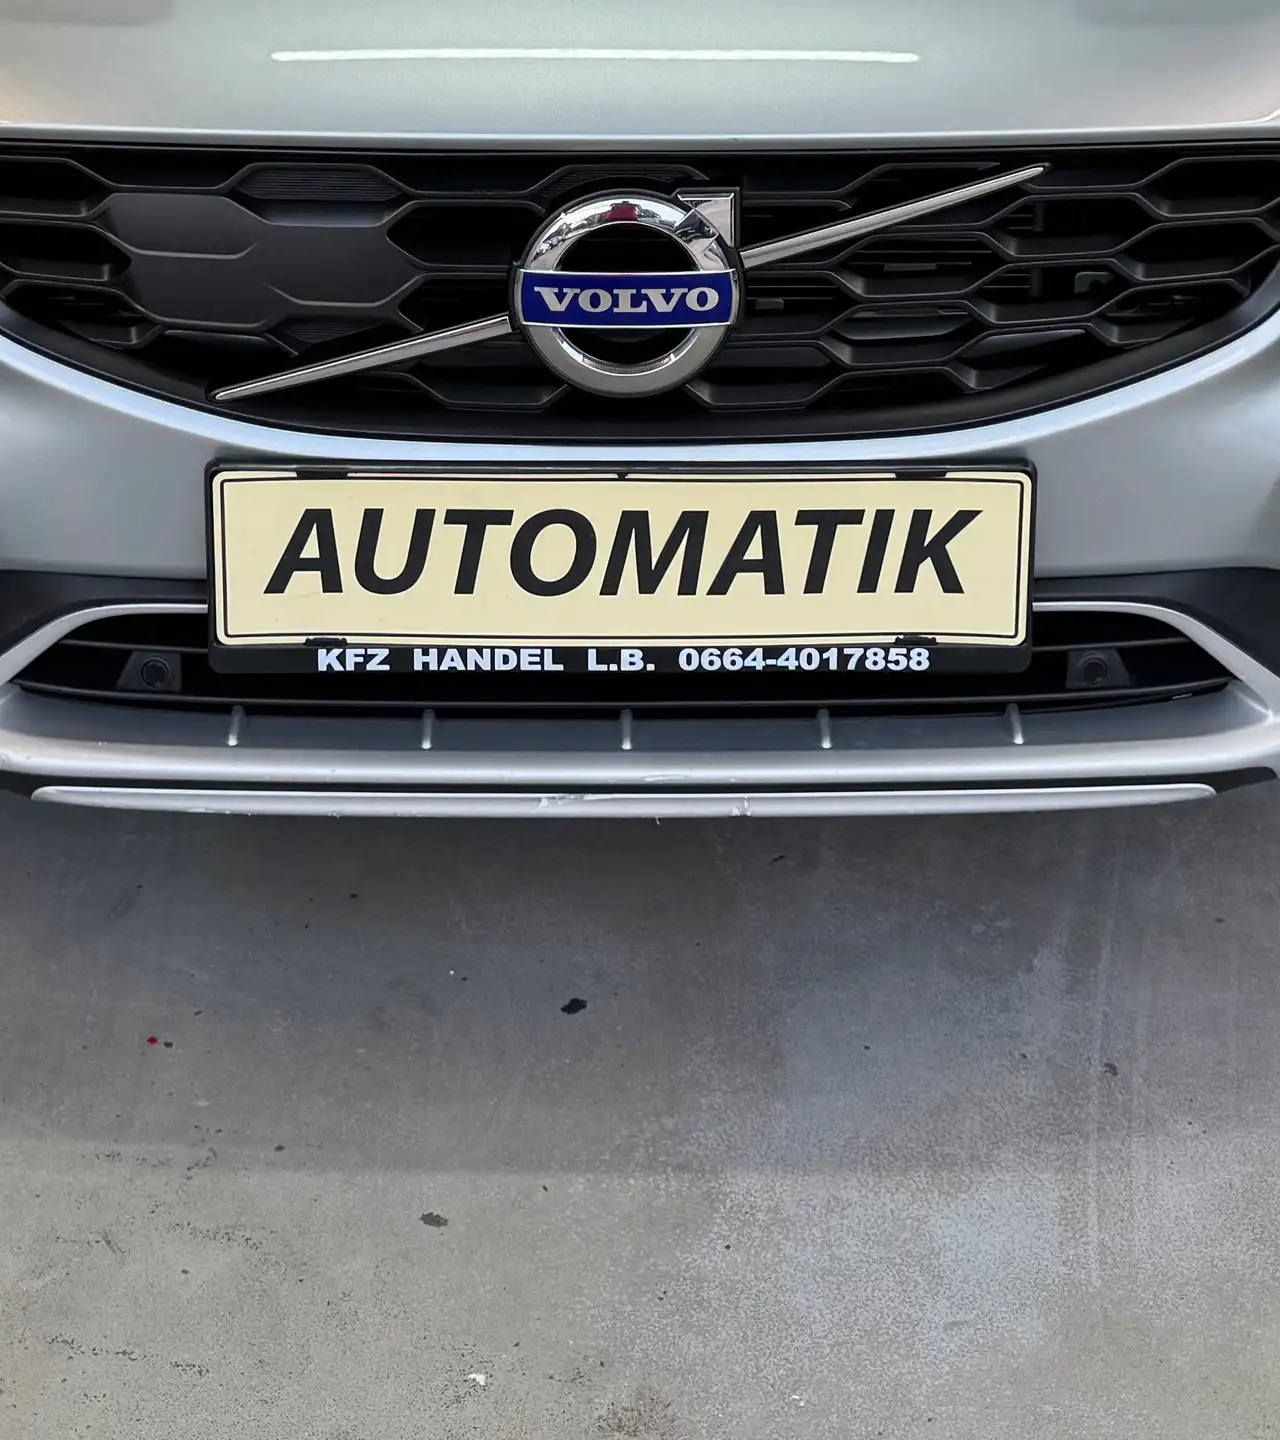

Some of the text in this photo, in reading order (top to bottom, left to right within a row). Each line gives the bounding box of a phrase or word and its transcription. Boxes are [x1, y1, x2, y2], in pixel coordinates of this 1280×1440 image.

[532, 284, 720, 316] VOLVO
[263, 505, 985, 599] AUTOMATIK
[317, 647, 931, 672] KFZ HANDEL L.B. 0664-4017858
